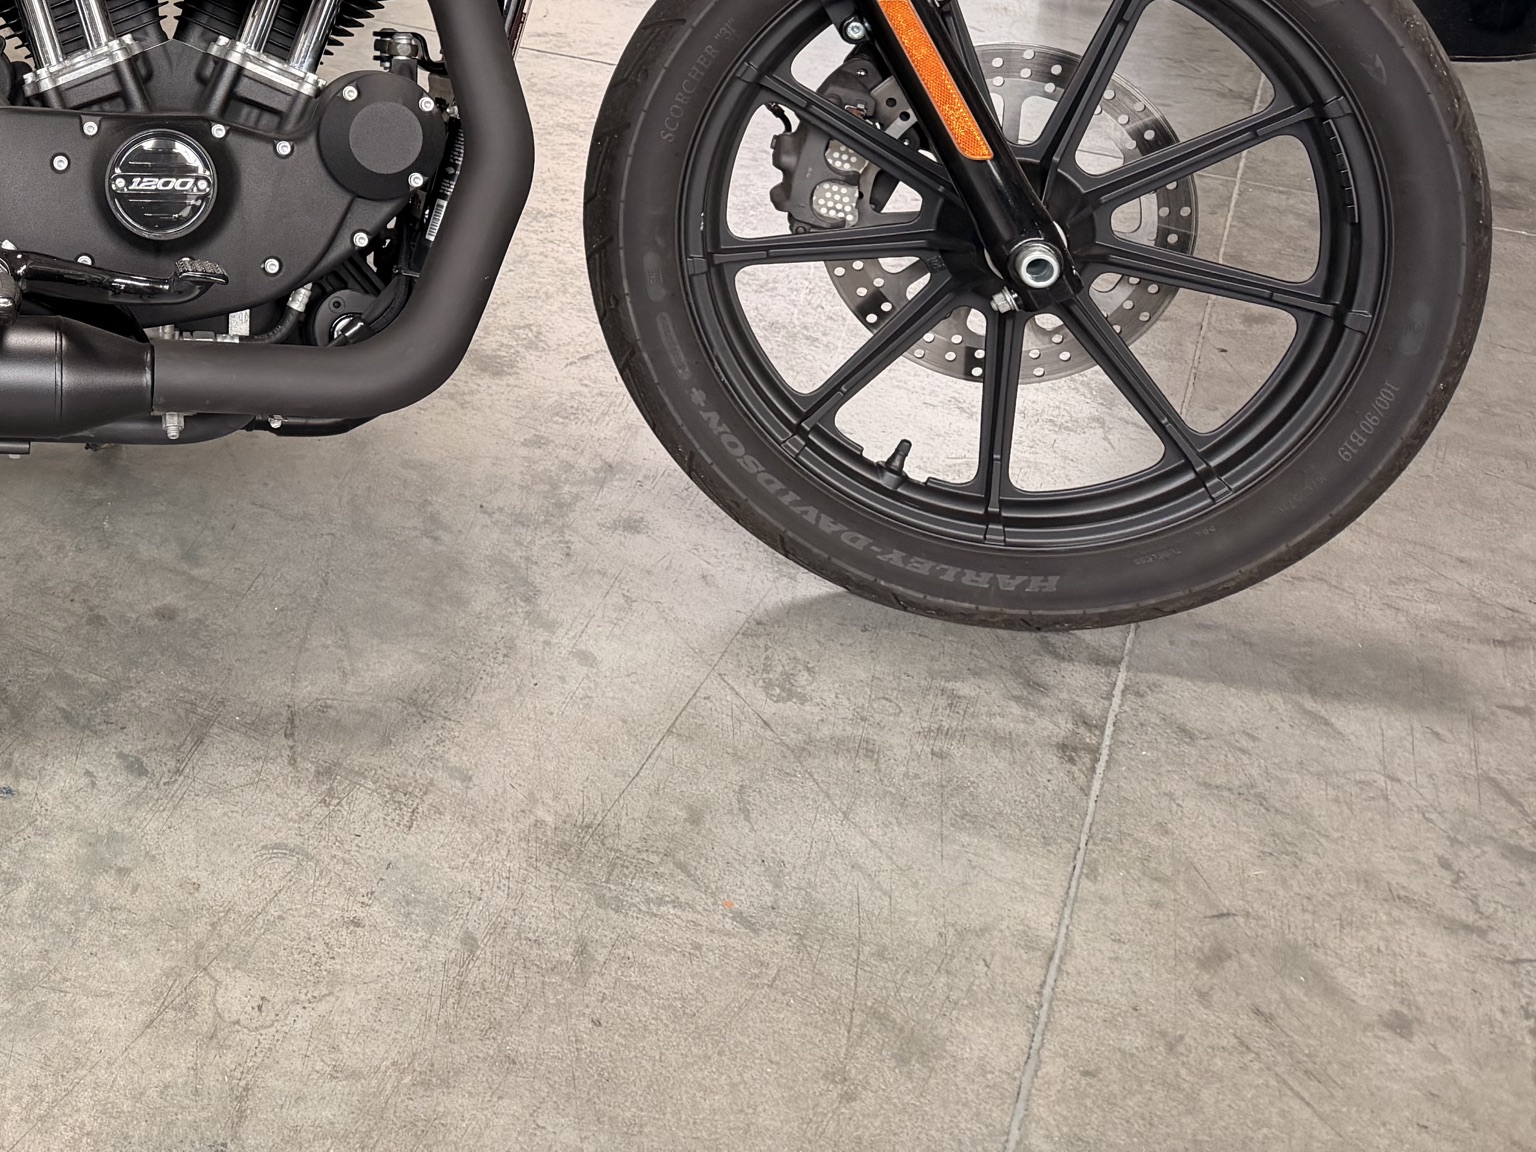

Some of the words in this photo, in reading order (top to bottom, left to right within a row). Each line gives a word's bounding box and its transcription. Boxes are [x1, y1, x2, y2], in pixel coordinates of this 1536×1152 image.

[660, 44, 720, 143] SCORCHER
[128, 177, 195, 191] 1200
[699, 408, 1062, 593] HARLEY-DAVIDSON
